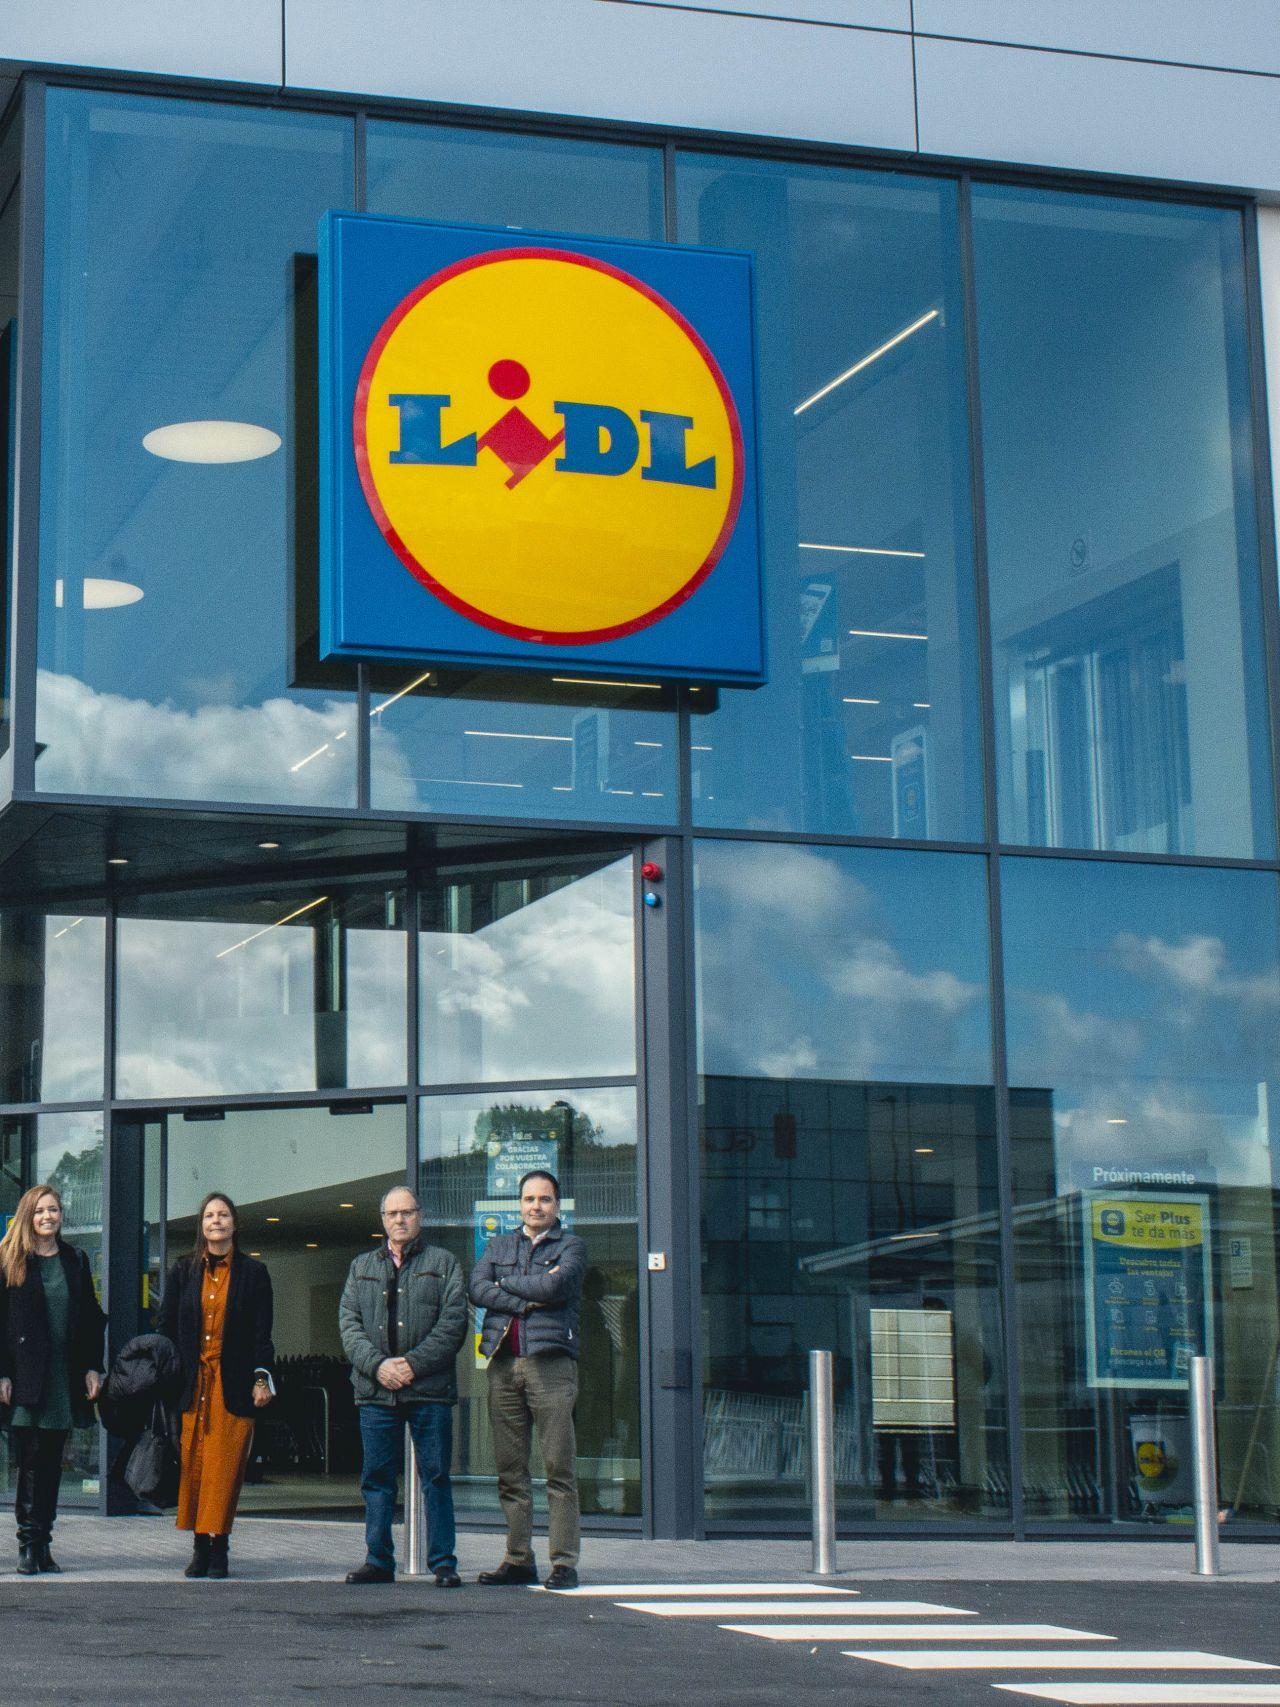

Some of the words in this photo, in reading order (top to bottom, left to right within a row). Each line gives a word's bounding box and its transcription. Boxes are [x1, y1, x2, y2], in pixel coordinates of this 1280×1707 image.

[515, 1154, 547, 1162] VUESTRA
[1093, 1166, 1196, 1185] Próximamente
[1135, 1209, 1156, 1223] Ser
[1160, 1211, 1191, 1226] Plus
[1131, 1225, 1144, 1238] te
[1148, 1225, 1166, 1239] da
